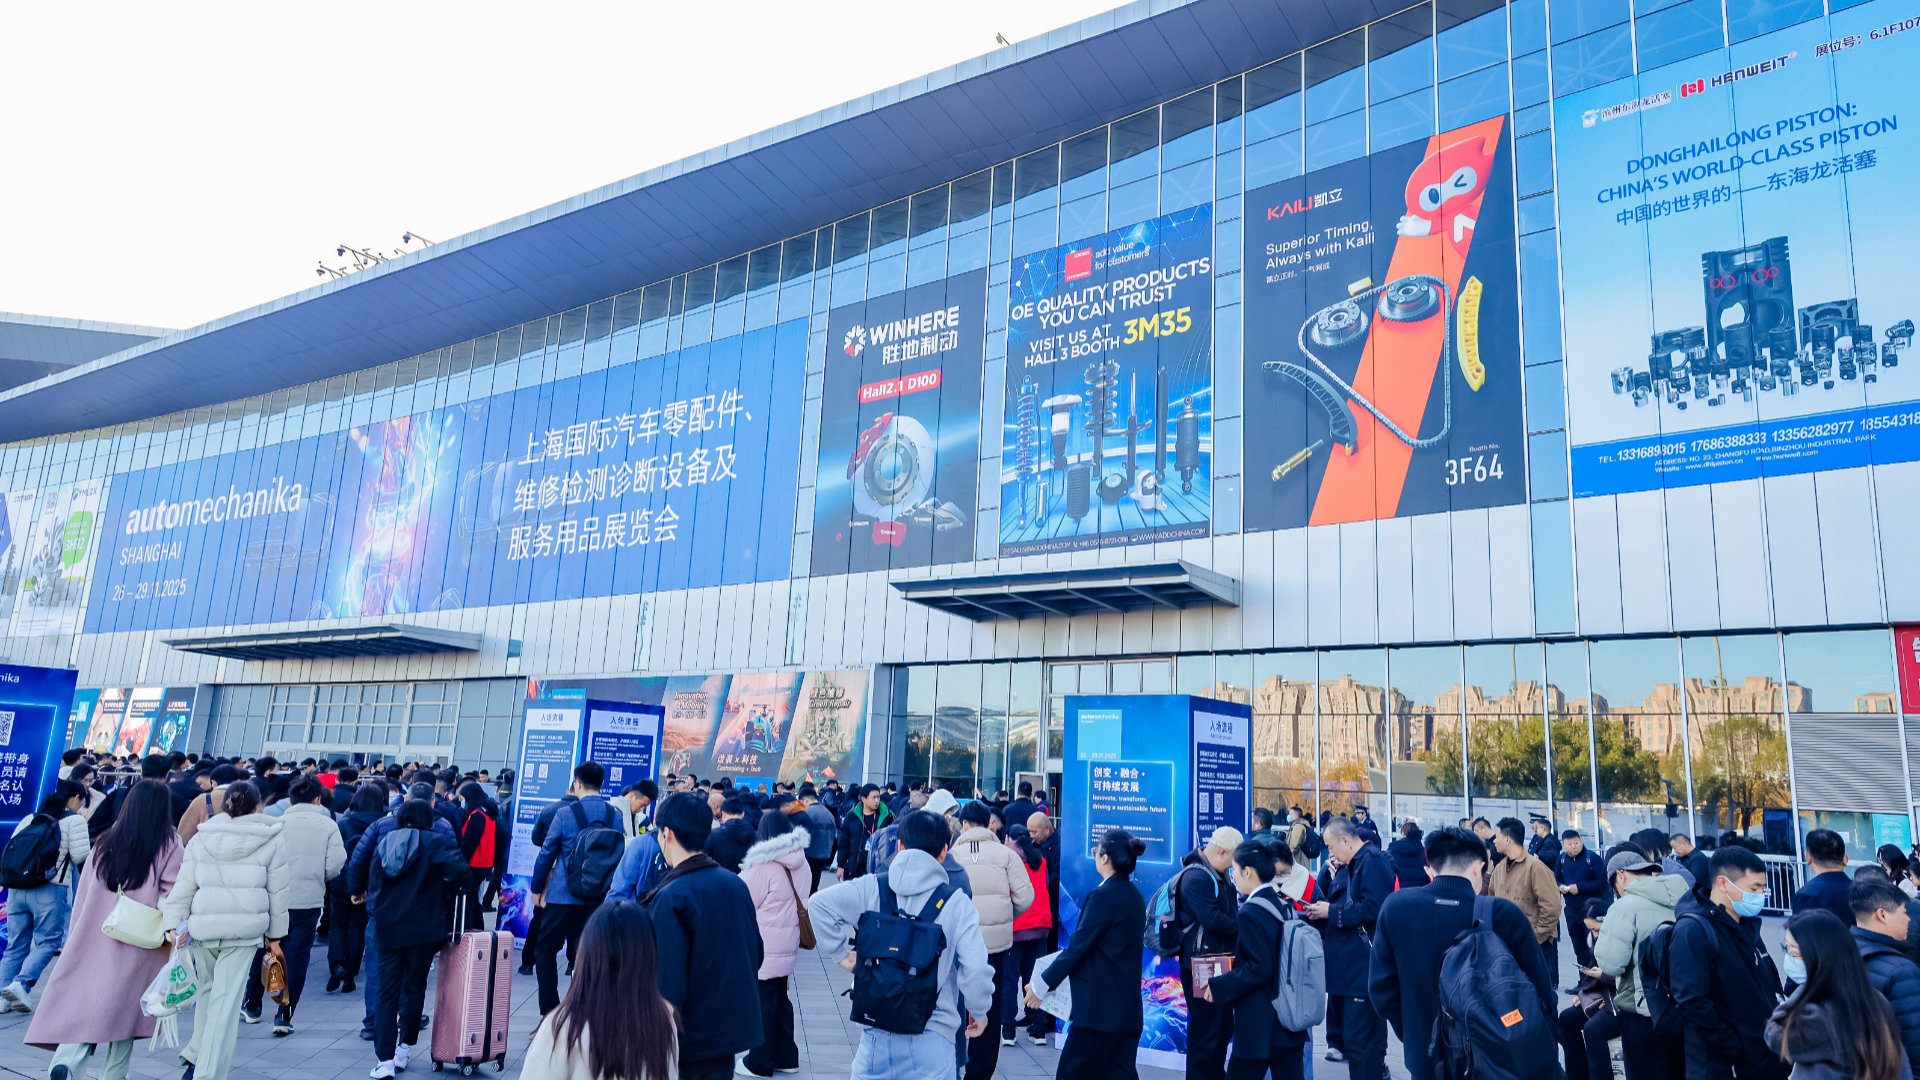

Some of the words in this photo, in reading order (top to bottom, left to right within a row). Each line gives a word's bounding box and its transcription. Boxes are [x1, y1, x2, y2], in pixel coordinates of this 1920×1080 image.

[1815, 35, 1861, 57] 展位号：
[1711, 55, 1788, 88] HENWEIT
[1627, 124, 1772, 174] DONGHAILONG
[1776, 102, 1857, 135] PISTON:
[1597, 174, 1668, 204] CHINA'S
[1672, 136, 1815, 185] WORLD-CLASS
[1819, 115, 1897, 149] PISTON
[1267, 196, 1313, 221] KAILI
[1314, 188, 1343, 208] 凯立
[1096, 247, 1110, 258] add
[1113, 242, 1134, 253] value
[1266, 233, 1320, 255] Superior
[1324, 221, 1373, 240] Timing,
[1266, 251, 1311, 270] Always
[1315, 242, 1342, 257] with
[1346, 232, 1375, 250] Kaili
[1095, 261, 1105, 270] for
[1108, 250, 1149, 267] customers
[1012, 302, 1034, 320] OE
[1037, 283, 1109, 313] QUALITY
[1113, 257, 1210, 296] PRODUCTS
[1040, 309, 1074, 329] YOU
[1078, 300, 1115, 320] CAN
[1119, 283, 1176, 311] TRUST
[870, 306, 959, 346] WINHERE
[1030, 335, 1064, 353] VISIT
[1069, 330, 1087, 345] US
[1092, 324, 1112, 340] AT
[1123, 306, 1193, 345] 3M35
[882, 330, 958, 365] 胜地制动
[1025, 354, 1058, 368] HALL
[1061, 347, 1068, 360] 3
[1071, 336, 1120, 358] BOOTH
[862, 380, 903, 399] Hall2.1
[907, 373, 937, 390] D100
[518, 388, 752, 465] 上海国际汽车零配件、
[1598, 456, 1616, 464] TEL.
[1617, 442, 1686, 461] 13316898015
[1691, 432, 1766, 452] 17686388333
[1772, 420, 1854, 442] 13356282977
[1715, 450, 1749, 460] ZHANGFU
[1807, 438, 1853, 448] INDUSTRIAL
[1855, 434, 1877, 443] PARK
[513, 444, 737, 512] 维修检测诊断设备及
[1445, 453, 1503, 485] 3F64
[126, 476, 302, 535] automechanika
[507, 504, 679, 560] 服务用品展览会
[120, 541, 182, 566] SHANGHAI
[112, 585, 125, 601] 26
[135, 579, 187, 600] 29.11.2025
[674, 692, 708, 700] Innovation
[809, 700, 828, 708] Green
[829, 700, 851, 709] Repair
[810, 687, 844, 699] 绿色维修
[1, 766, 27, 778] 员请
[741, 754, 758, 765] 科技
[0, 780, 23, 791] 名认
[1093, 780, 1139, 792] 可持续发展
